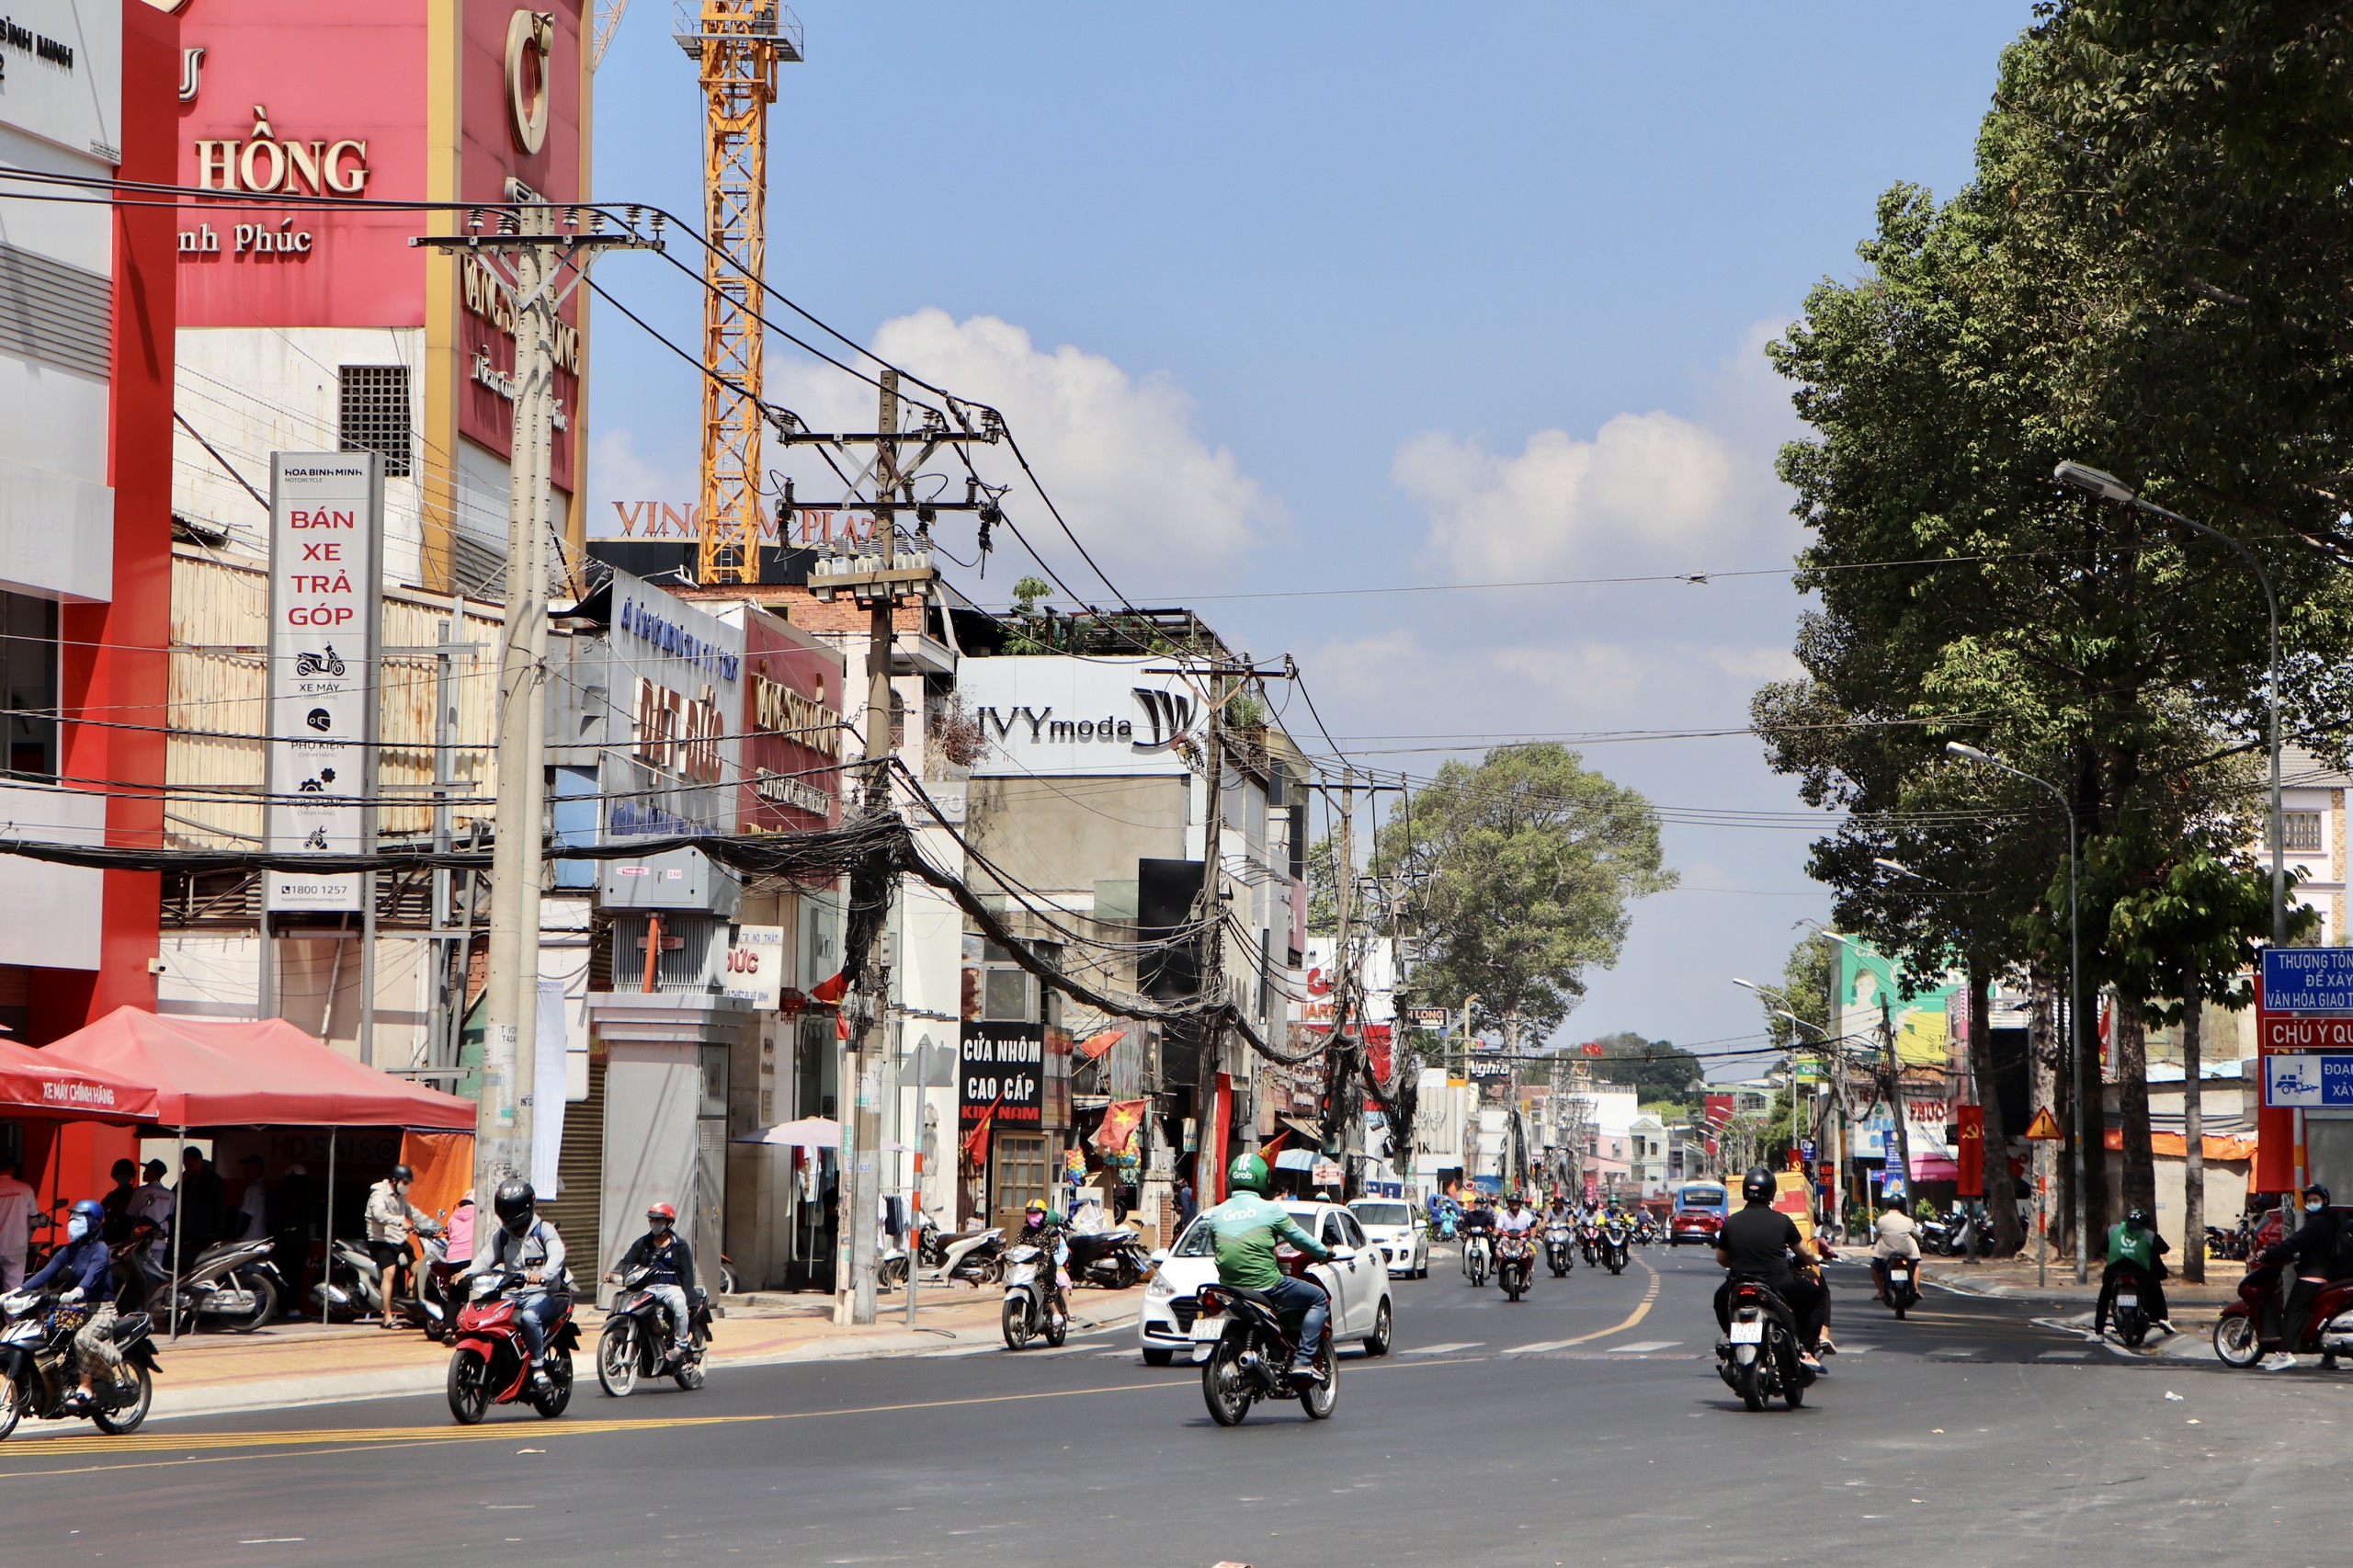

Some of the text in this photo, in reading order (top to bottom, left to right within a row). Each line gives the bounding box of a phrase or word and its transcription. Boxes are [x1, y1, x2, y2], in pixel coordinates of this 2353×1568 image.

[195, 105, 370, 194] HỒNG
[233, 217, 312, 253] Phúc
[290, 506, 354, 529] BÁN
[301, 543, 341, 561] XE
[290, 569, 352, 594] TRẢ
[289, 602, 354, 626] GÓP
[299, 681, 340, 692] XE MÁY
[977, 706, 1132, 737] IVYmoda
[291, 885, 347, 894] 1800 1257
[2279, 950, 2353, 973] THƯỢNG TÔN
[2305, 968, 2353, 987] ĐỂ XÂY
[2267, 989, 2290, 1008] VĂN
[2292, 989, 2316, 1008] HÓA
[2318, 992, 2345, 1007] GIAO
[1415, 1010, 1444, 1019] LONG
[2273, 1020, 2312, 1044] CHÚ
[2316, 1019, 2329, 1044] Ý
[963, 1031, 1041, 1062] CỬA NHÔM
[2324, 1063, 2353, 1078] ĐOẠ
[42, 1079, 115, 1106] XE MÁY CHÍNH HÃNG
[968, 1072, 1035, 1101] CAO CẤP
[998, 1107, 1040, 1120] NAM
[1233, 1170, 1253, 1179] Grab
[1222, 1206, 1257, 1221] Grab
